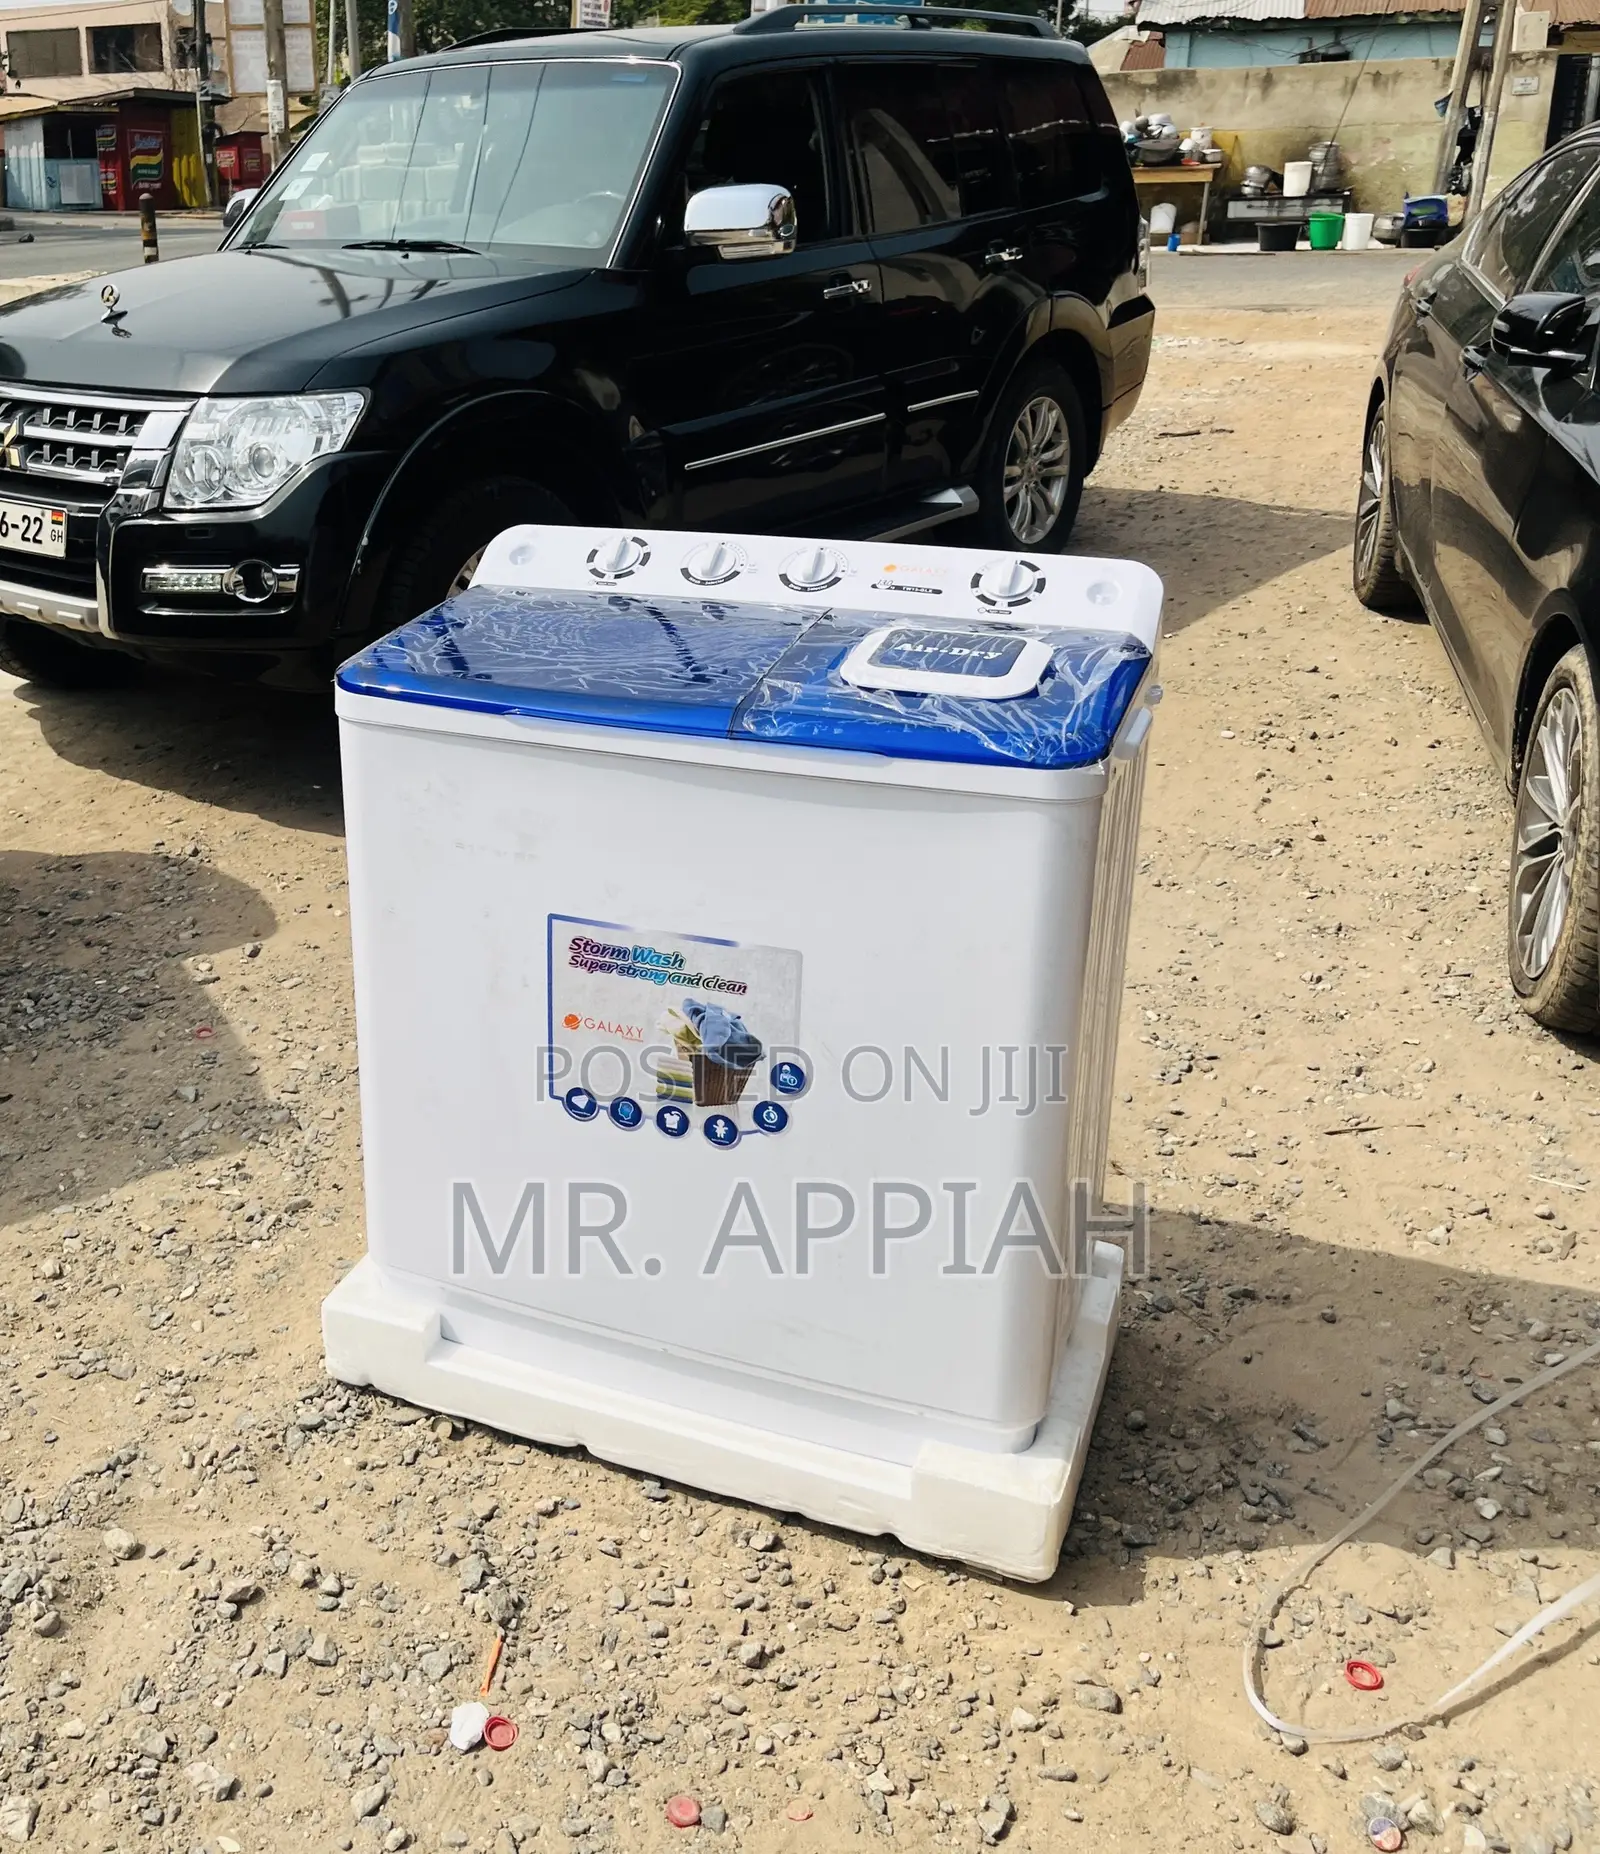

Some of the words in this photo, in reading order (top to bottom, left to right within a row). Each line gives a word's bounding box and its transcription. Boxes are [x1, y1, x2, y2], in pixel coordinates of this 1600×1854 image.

[50, 529, 63, 543] GH
[894, 643, 1003, 660] Air-Dry
[569, 937, 629, 960] Storm
[631, 945, 685, 968] Wash
[569, 954, 616, 973] Super
[617, 963, 668, 984] strong
[670, 973, 701, 987] and
[703, 976, 748, 994] clean
[584, 1017, 644, 1038] GALAXY
